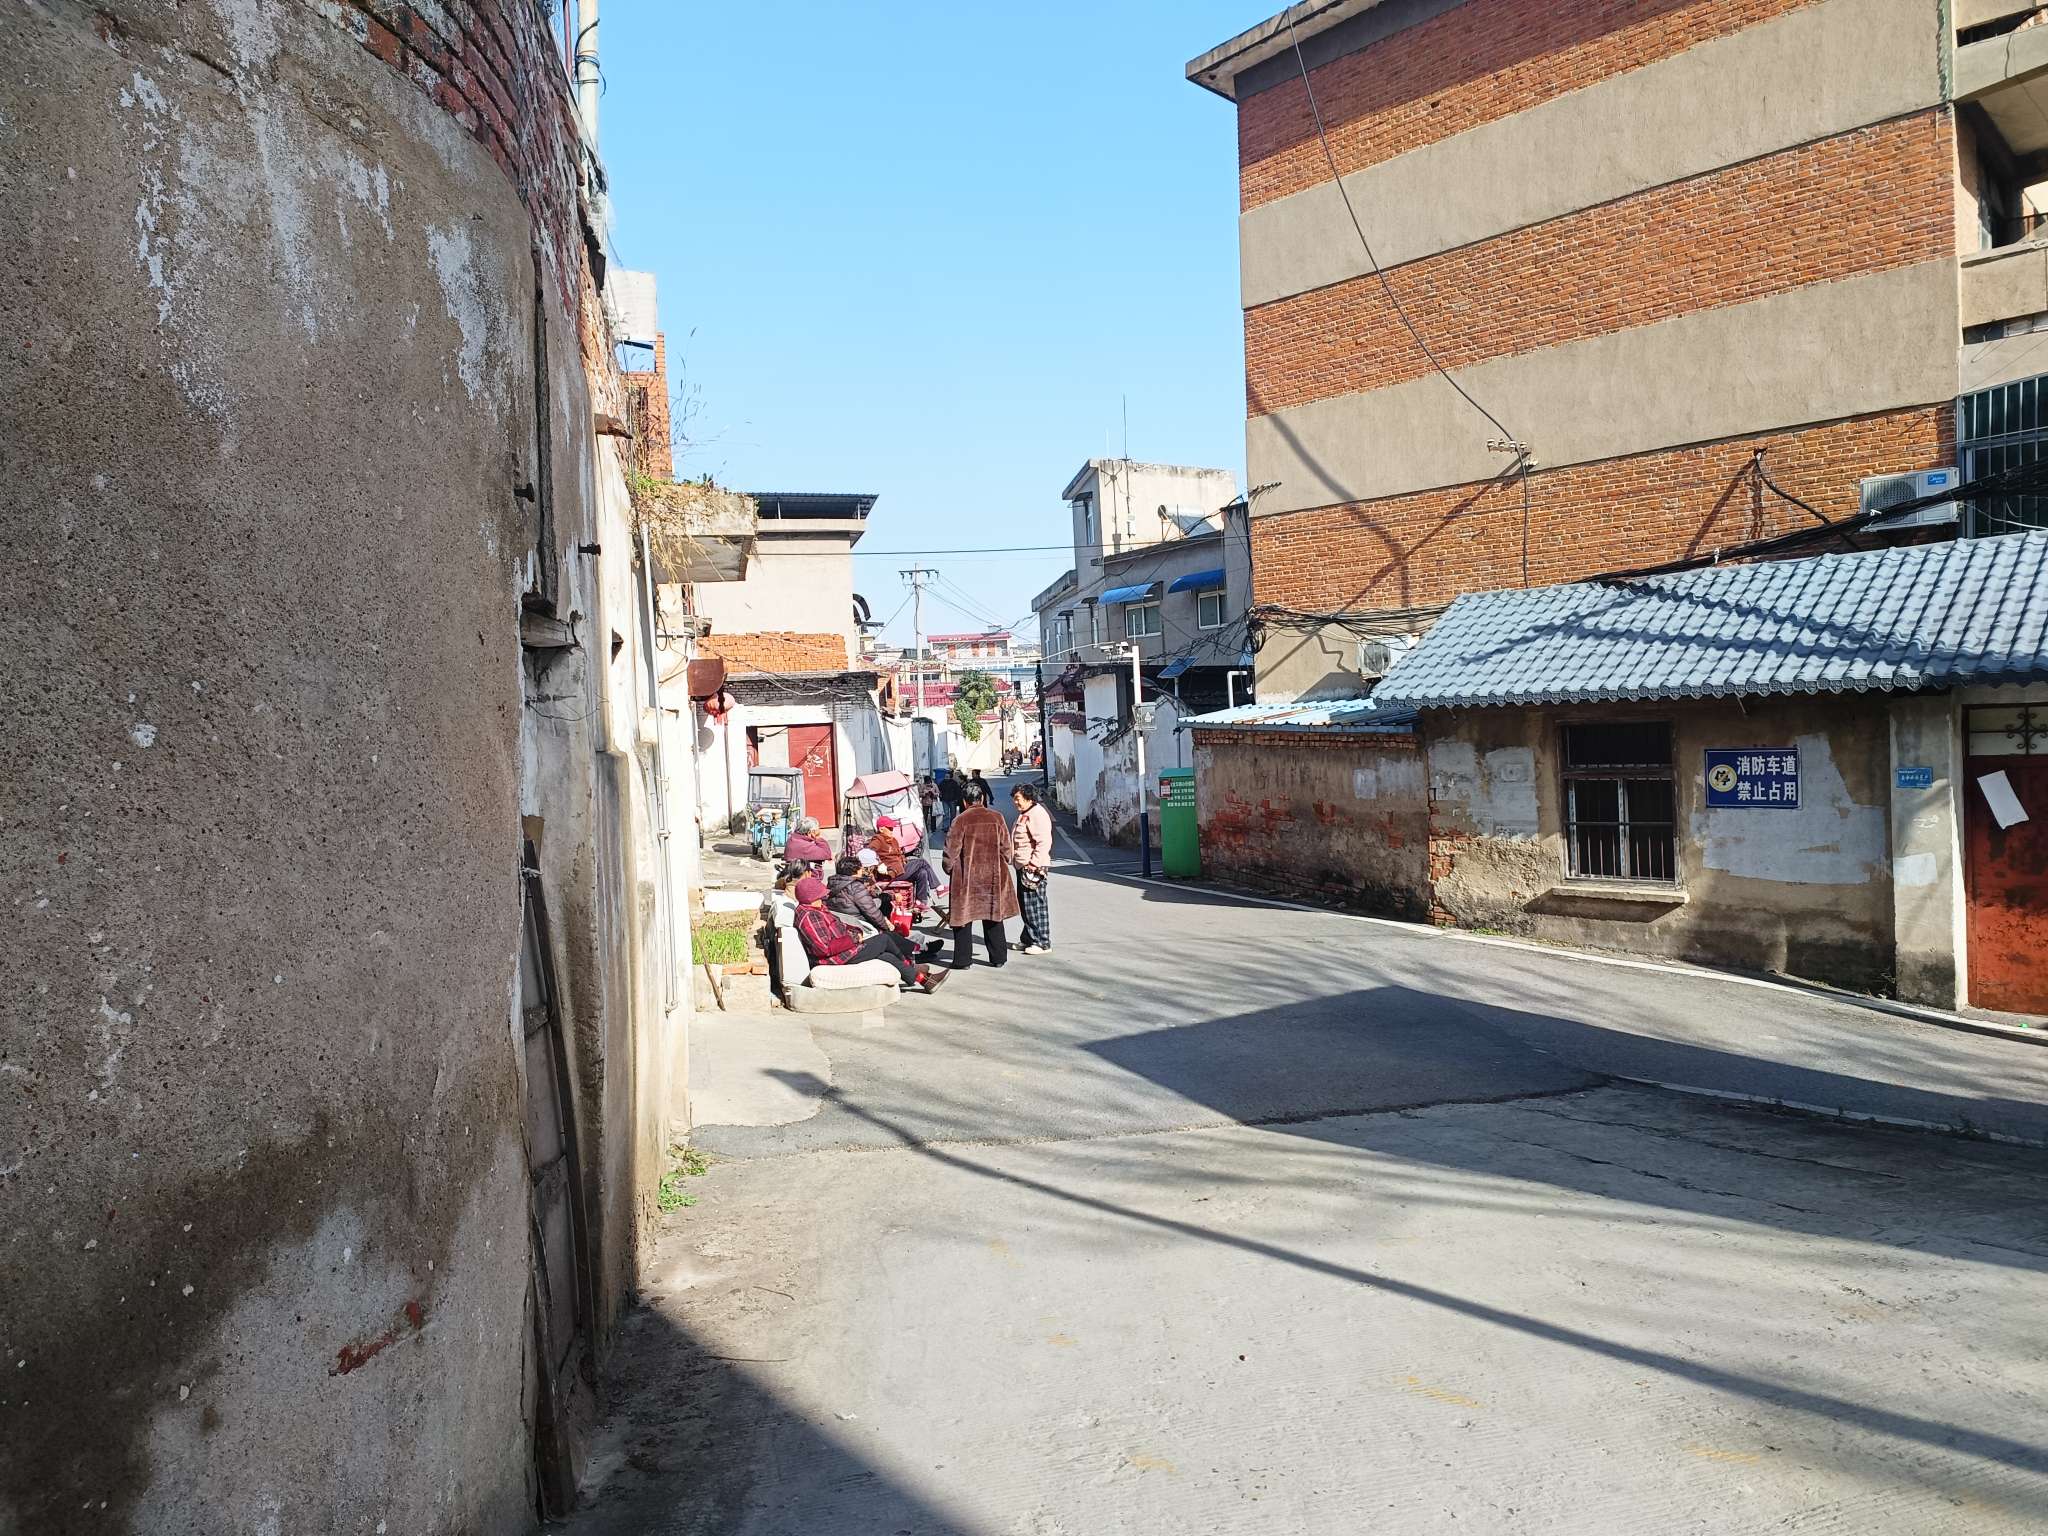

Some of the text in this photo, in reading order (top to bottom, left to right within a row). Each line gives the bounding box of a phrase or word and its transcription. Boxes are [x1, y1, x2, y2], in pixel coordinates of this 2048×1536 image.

[1737, 755, 1797, 776] 消防车道
[1737, 780, 1797, 801] 禁止占用
